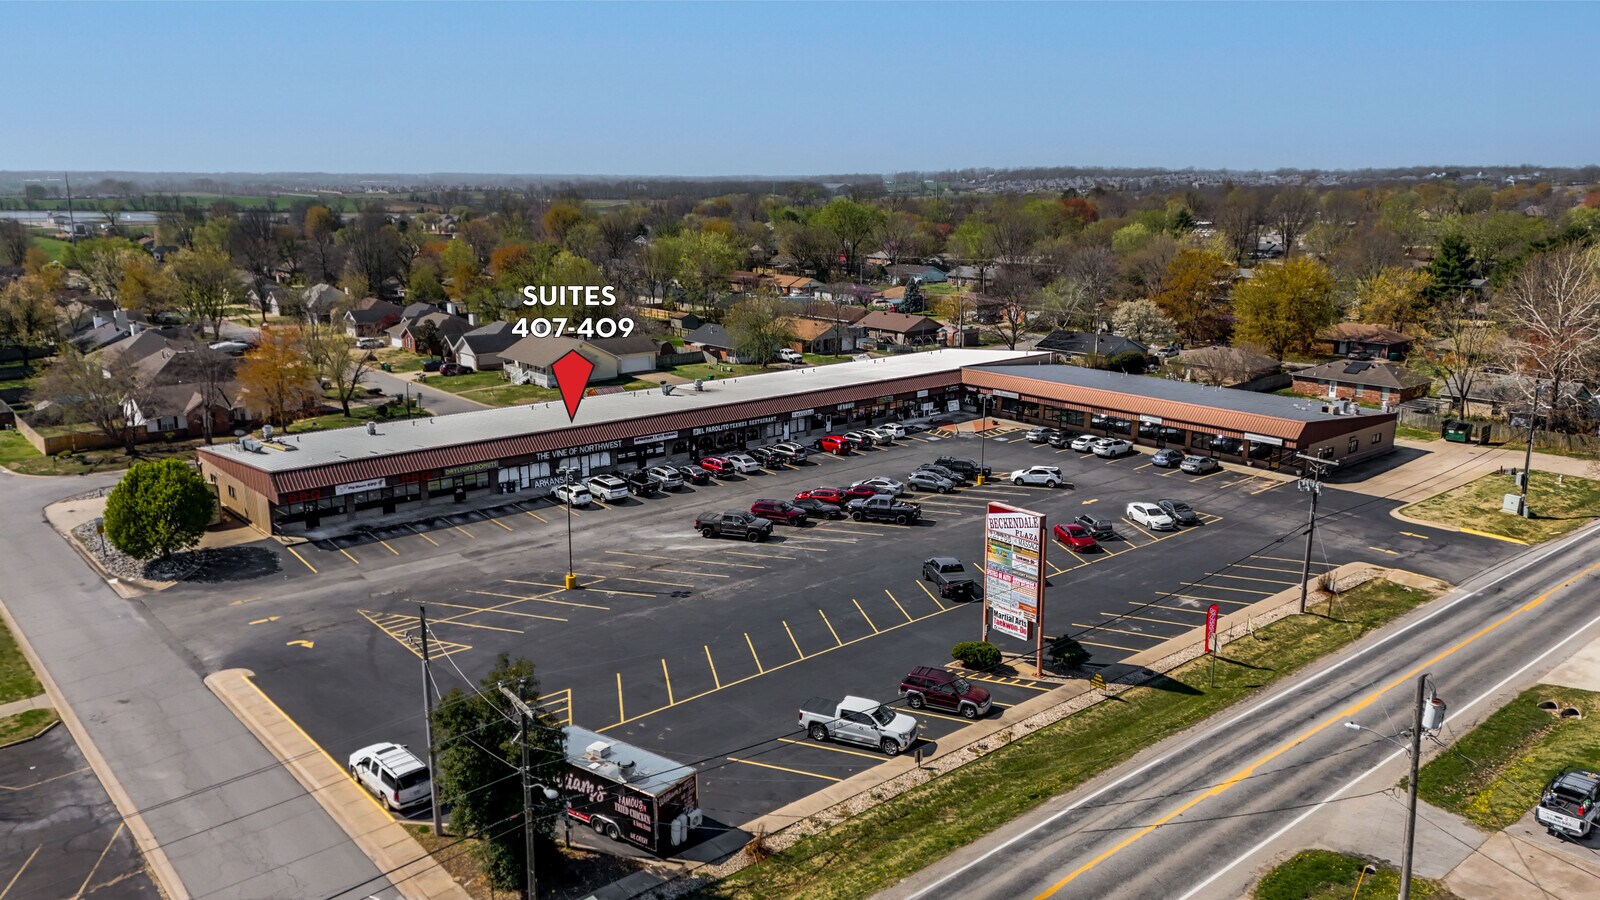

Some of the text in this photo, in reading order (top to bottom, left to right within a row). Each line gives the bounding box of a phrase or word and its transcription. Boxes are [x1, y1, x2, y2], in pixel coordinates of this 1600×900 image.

[706, 424, 729, 433] FAROLITO
[536, 440, 623, 461] THE VINE OF NORTHWEST
[445, 461, 497, 476] DAYLIGHT DONUTS
[988, 516, 1039, 529] BECKENDALE
[1015, 529, 1039, 542] PLAZA
[1018, 539, 1039, 550] MASSAGE
[993, 610, 1014, 623] Martial
[1015, 616, 1027, 628] Arts
[993, 616, 1027, 635] Taekwon-Do
[618, 795, 643, 810] FAMOUS
[614, 802, 629, 816] FRIED
[629, 808, 651, 825] CHICKEN
